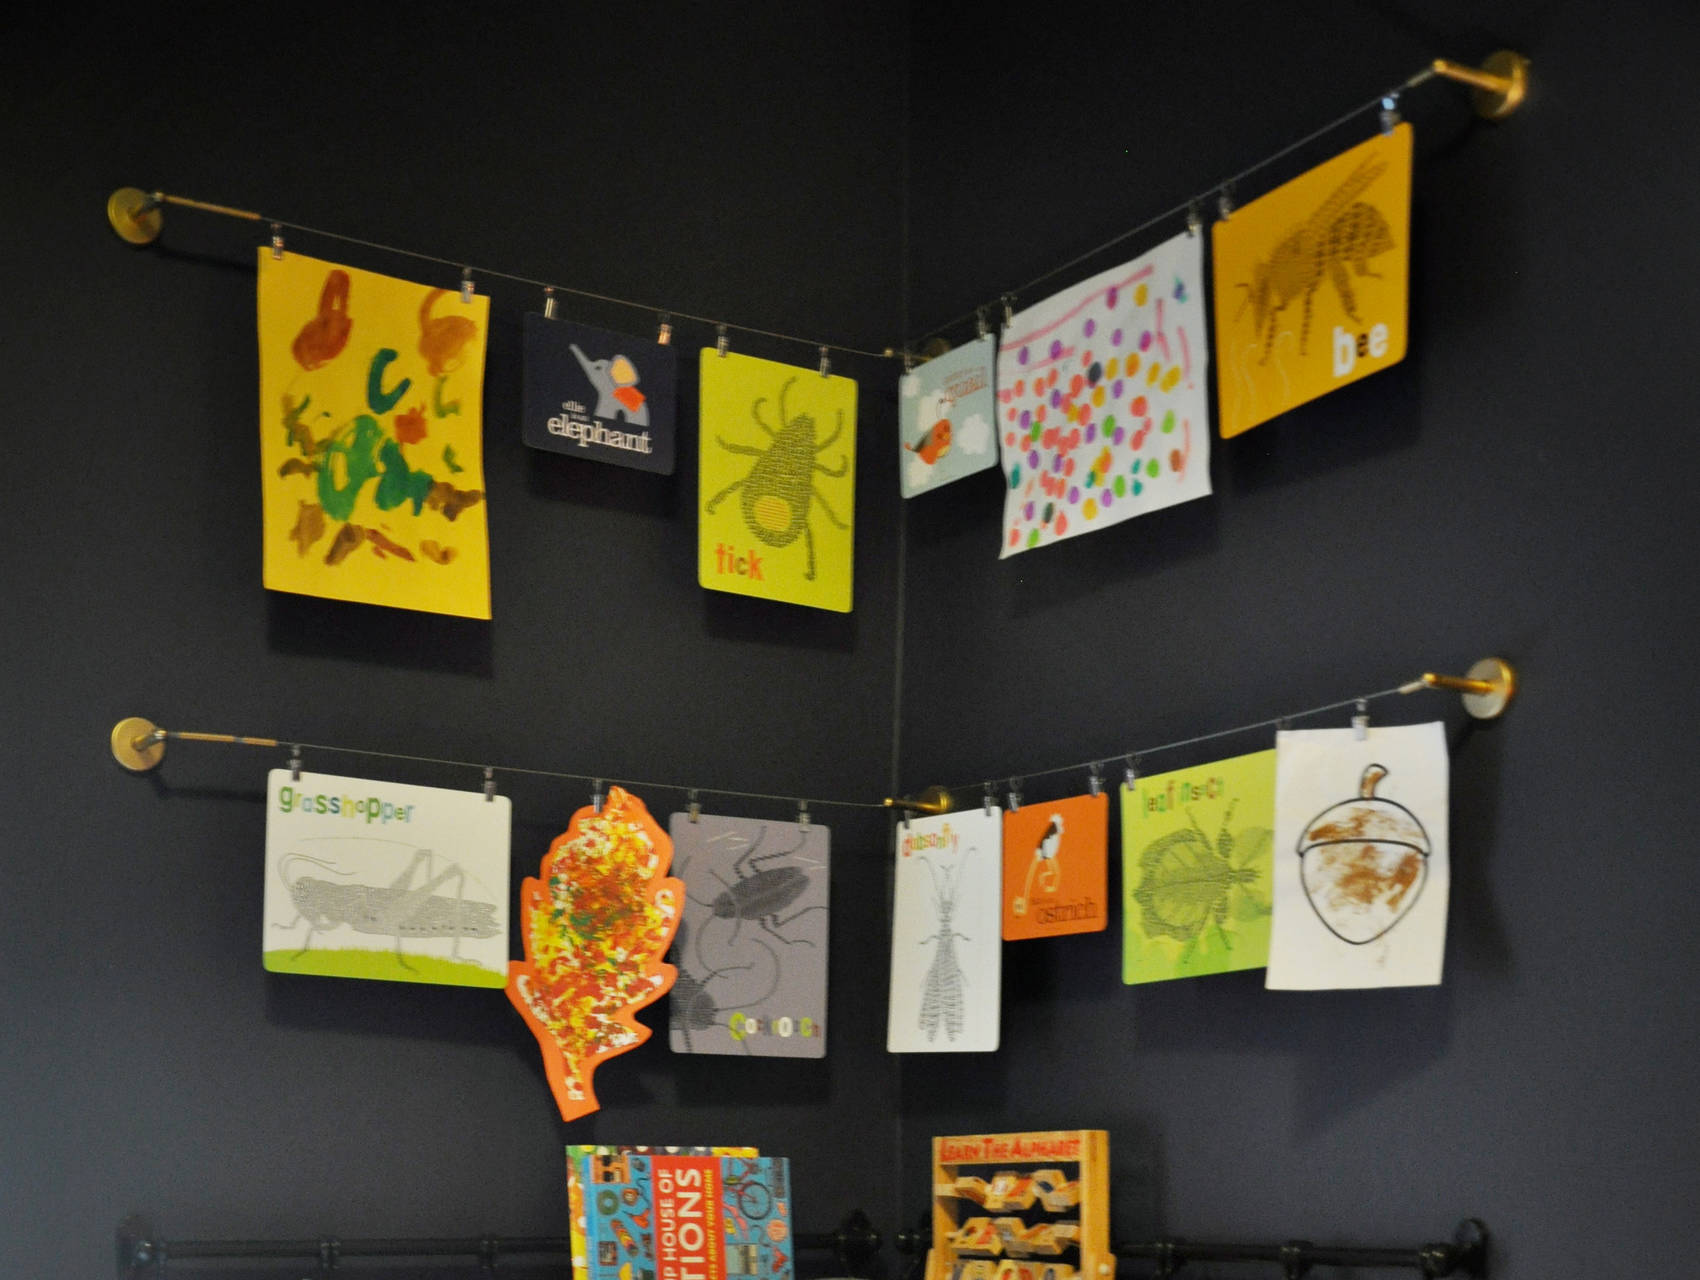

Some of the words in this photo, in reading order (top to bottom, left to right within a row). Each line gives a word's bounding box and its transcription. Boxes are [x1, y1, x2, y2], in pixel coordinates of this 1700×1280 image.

[1332, 322, 1389, 378] bee
[547, 413, 653, 454] elephant
[715, 541, 765, 582] tick
[279, 785, 415, 824] grasshopper
[658, 1168, 674, 1194] OF
[660, 1198, 677, 1262] HOUSE
